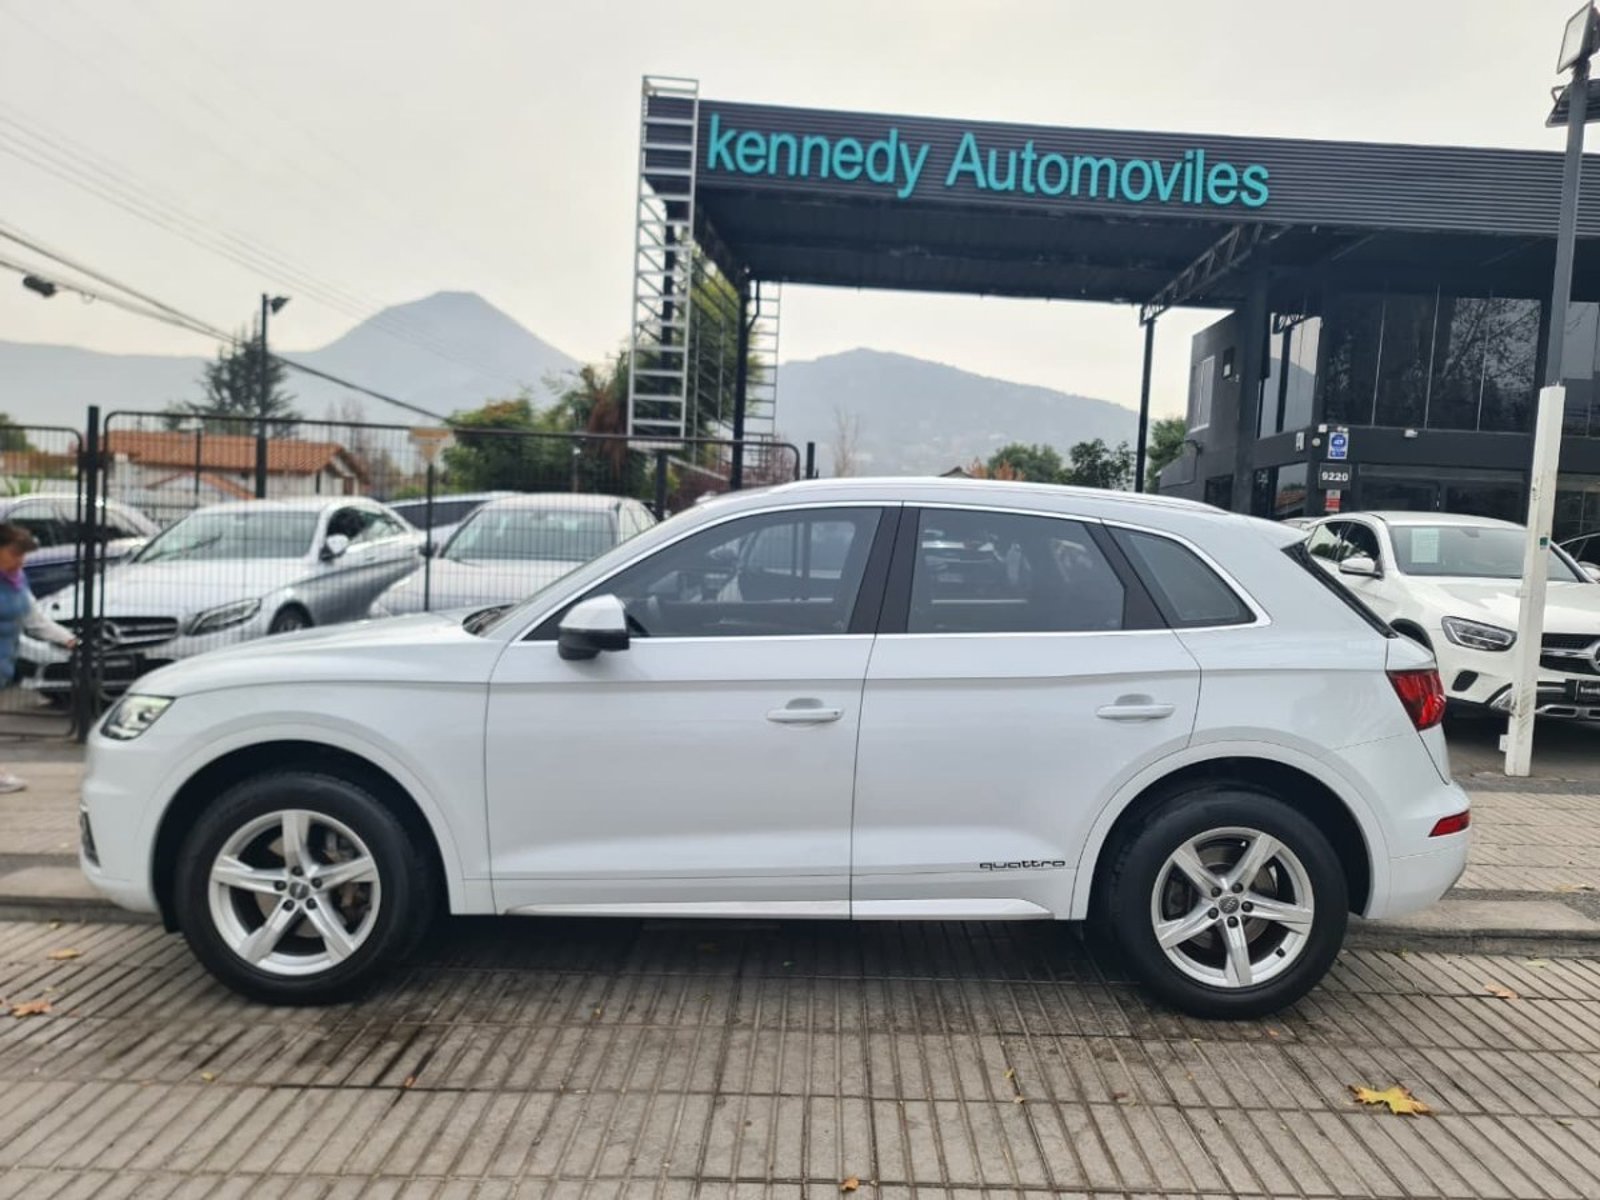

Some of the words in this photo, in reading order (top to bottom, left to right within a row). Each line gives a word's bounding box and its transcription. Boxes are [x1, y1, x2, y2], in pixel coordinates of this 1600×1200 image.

[707, 113, 930, 198] kennedy
[945, 132, 1269, 207] Automoviles
[1322, 472, 1348, 481] 9220
[979, 860, 1065, 871] quattro
